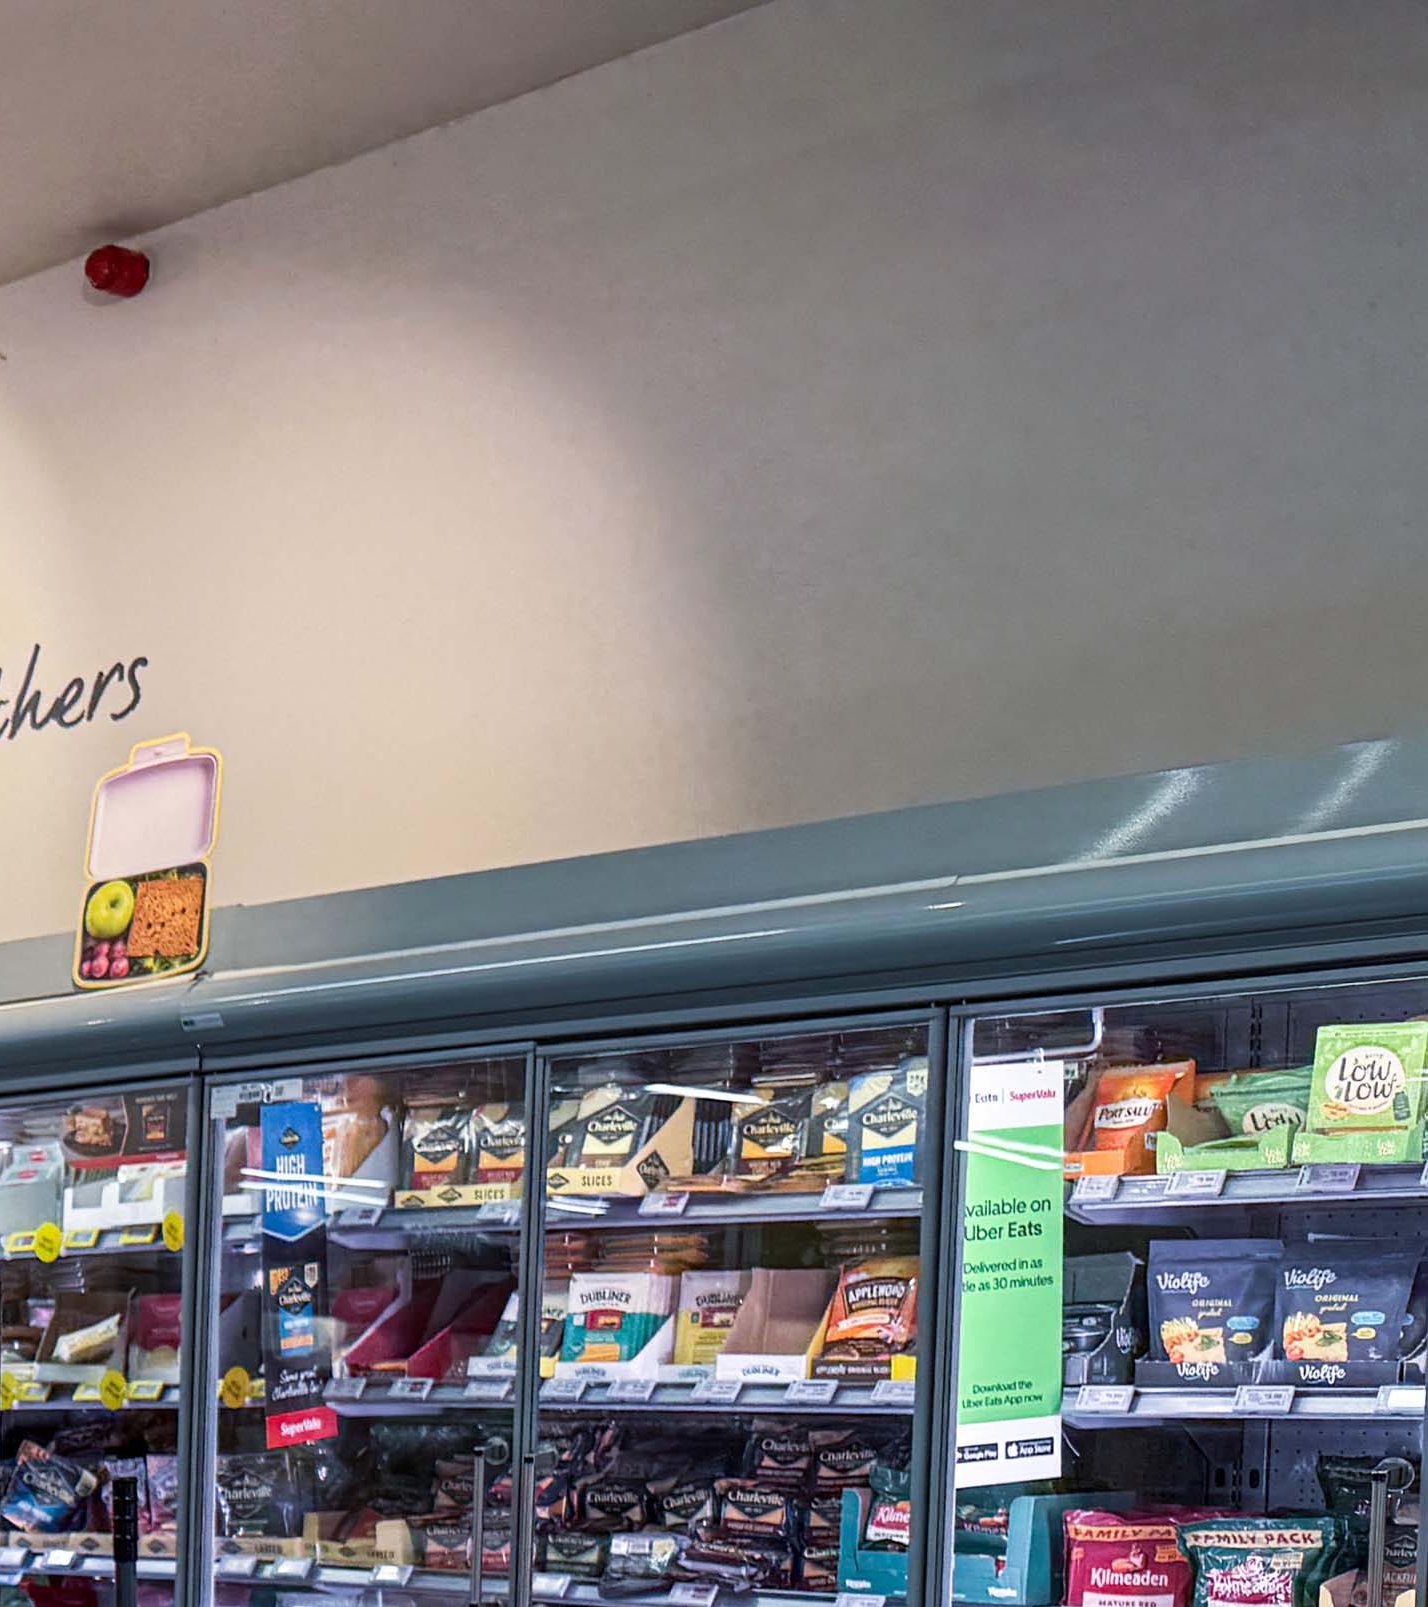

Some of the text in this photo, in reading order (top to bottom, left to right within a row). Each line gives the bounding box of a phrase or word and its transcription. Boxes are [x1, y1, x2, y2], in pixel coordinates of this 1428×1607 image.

[1009, 1088, 1055, 1102] SuperValu
[861, 1111, 917, 1126] Charleville
[581, 1175, 613, 1188] SLICES
[266, 1182, 317, 1212] PROTEIN
[475, 1189, 505, 1200] SLICES
[965, 1198, 1051, 1217] vailable on
[965, 1222, 1043, 1240] Uber Eats
[963, 1258, 1043, 1274] Delivered in as
[993, 1275, 1053, 1290] 30 minutes
[1157, 1272, 1209, 1294] Violife
[1285, 1269, 1337, 1290] Violife
[579, 1290, 631, 1306] DUBLINER
[1315, 1294, 1359, 1304] ORIGINAL
[1177, 1362, 1220, 1381] Violife
[1299, 1365, 1347, 1384] Violife
[973, 1382, 1016, 1394] Download
[1072, 1525, 1139, 1541] FAMILY
[1193, 1530, 1315, 1548] FAMILY PACK
[1090, 1566, 1169, 1588] Kilmeaden
